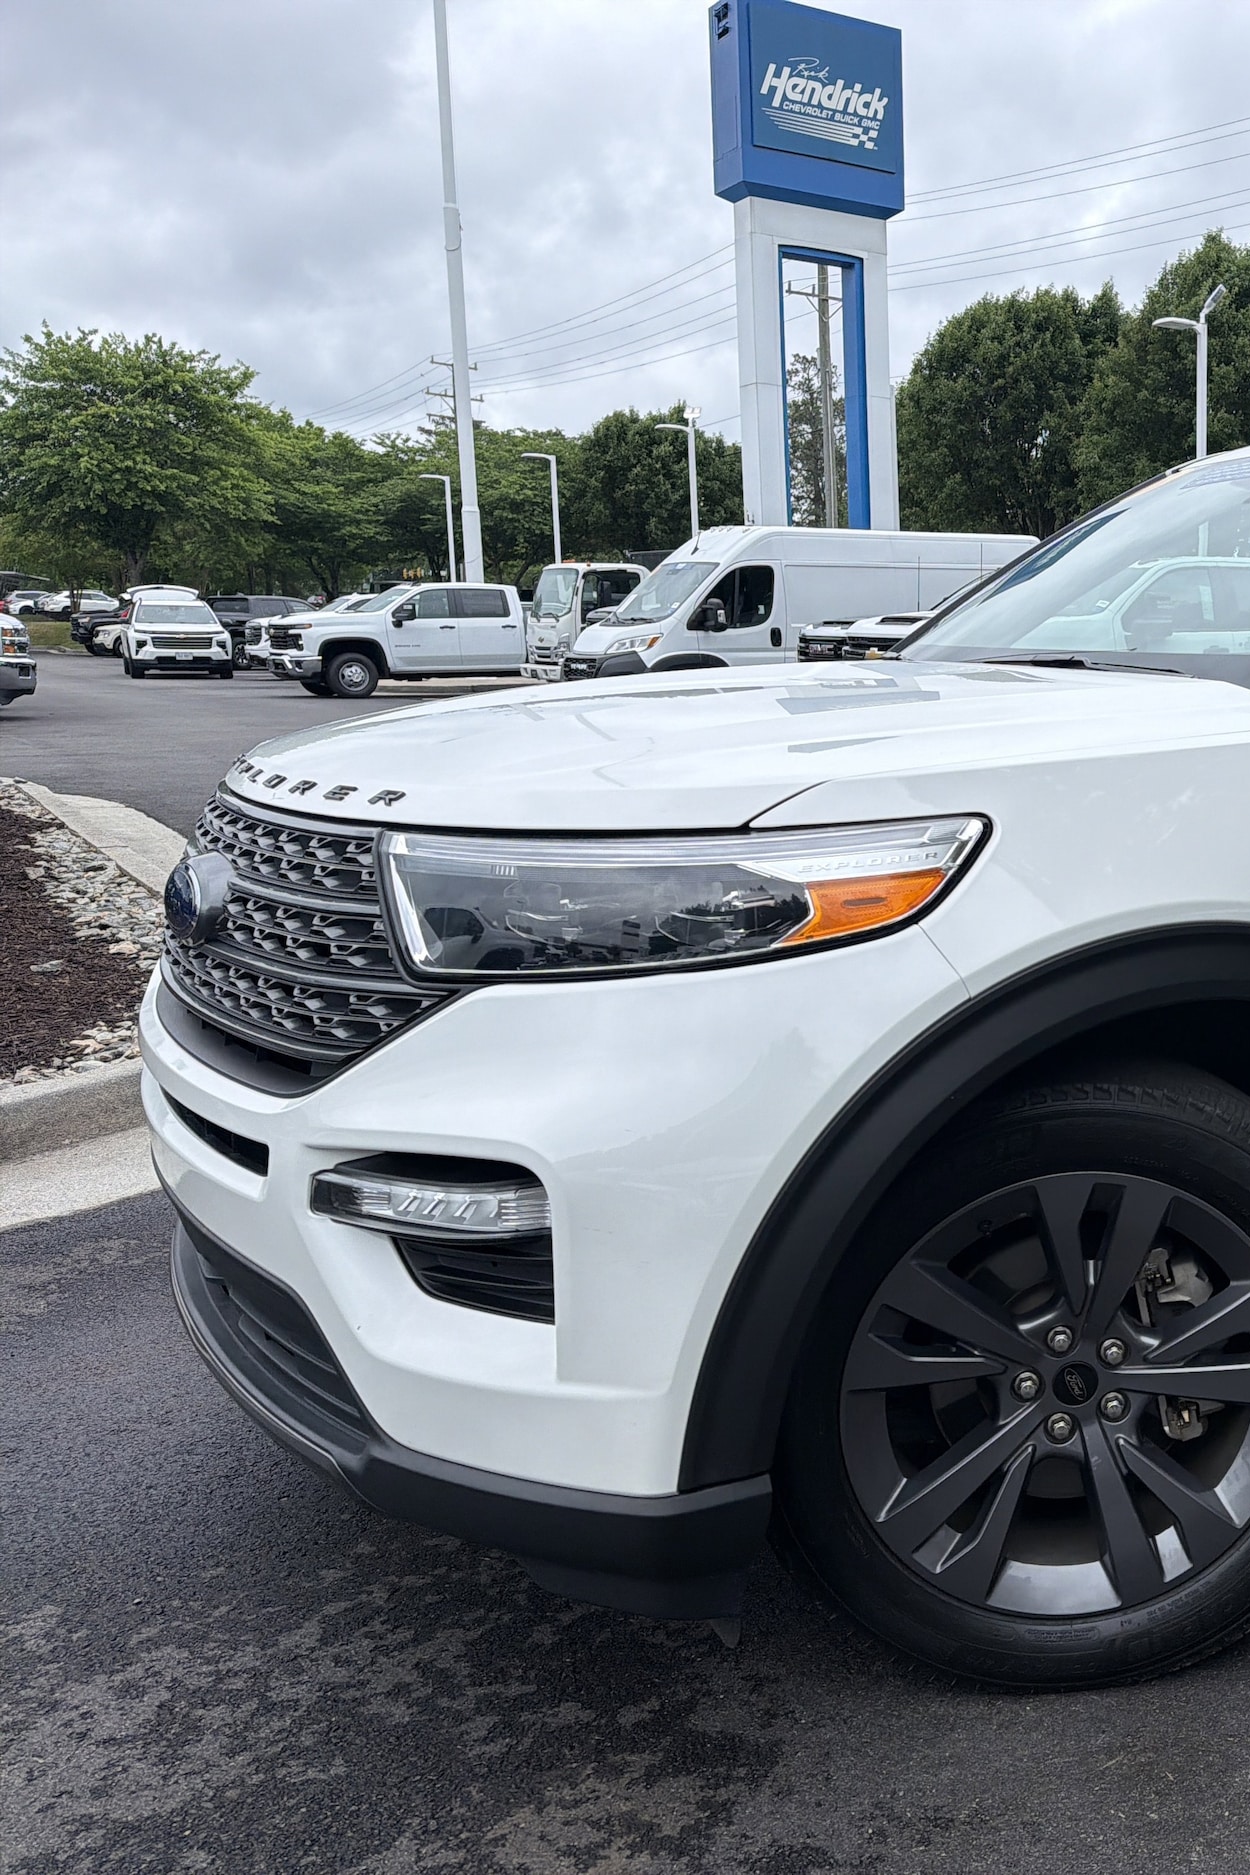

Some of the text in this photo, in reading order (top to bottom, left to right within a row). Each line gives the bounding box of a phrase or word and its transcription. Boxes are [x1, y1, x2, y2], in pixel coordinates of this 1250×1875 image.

[760, 63, 888, 120] Hendrick
[783, 101, 881, 130] CHEVROLET BUICK GMC
[798, 852, 938, 873] EXPLORER
[1066, 1374, 1083, 1396] Ford
